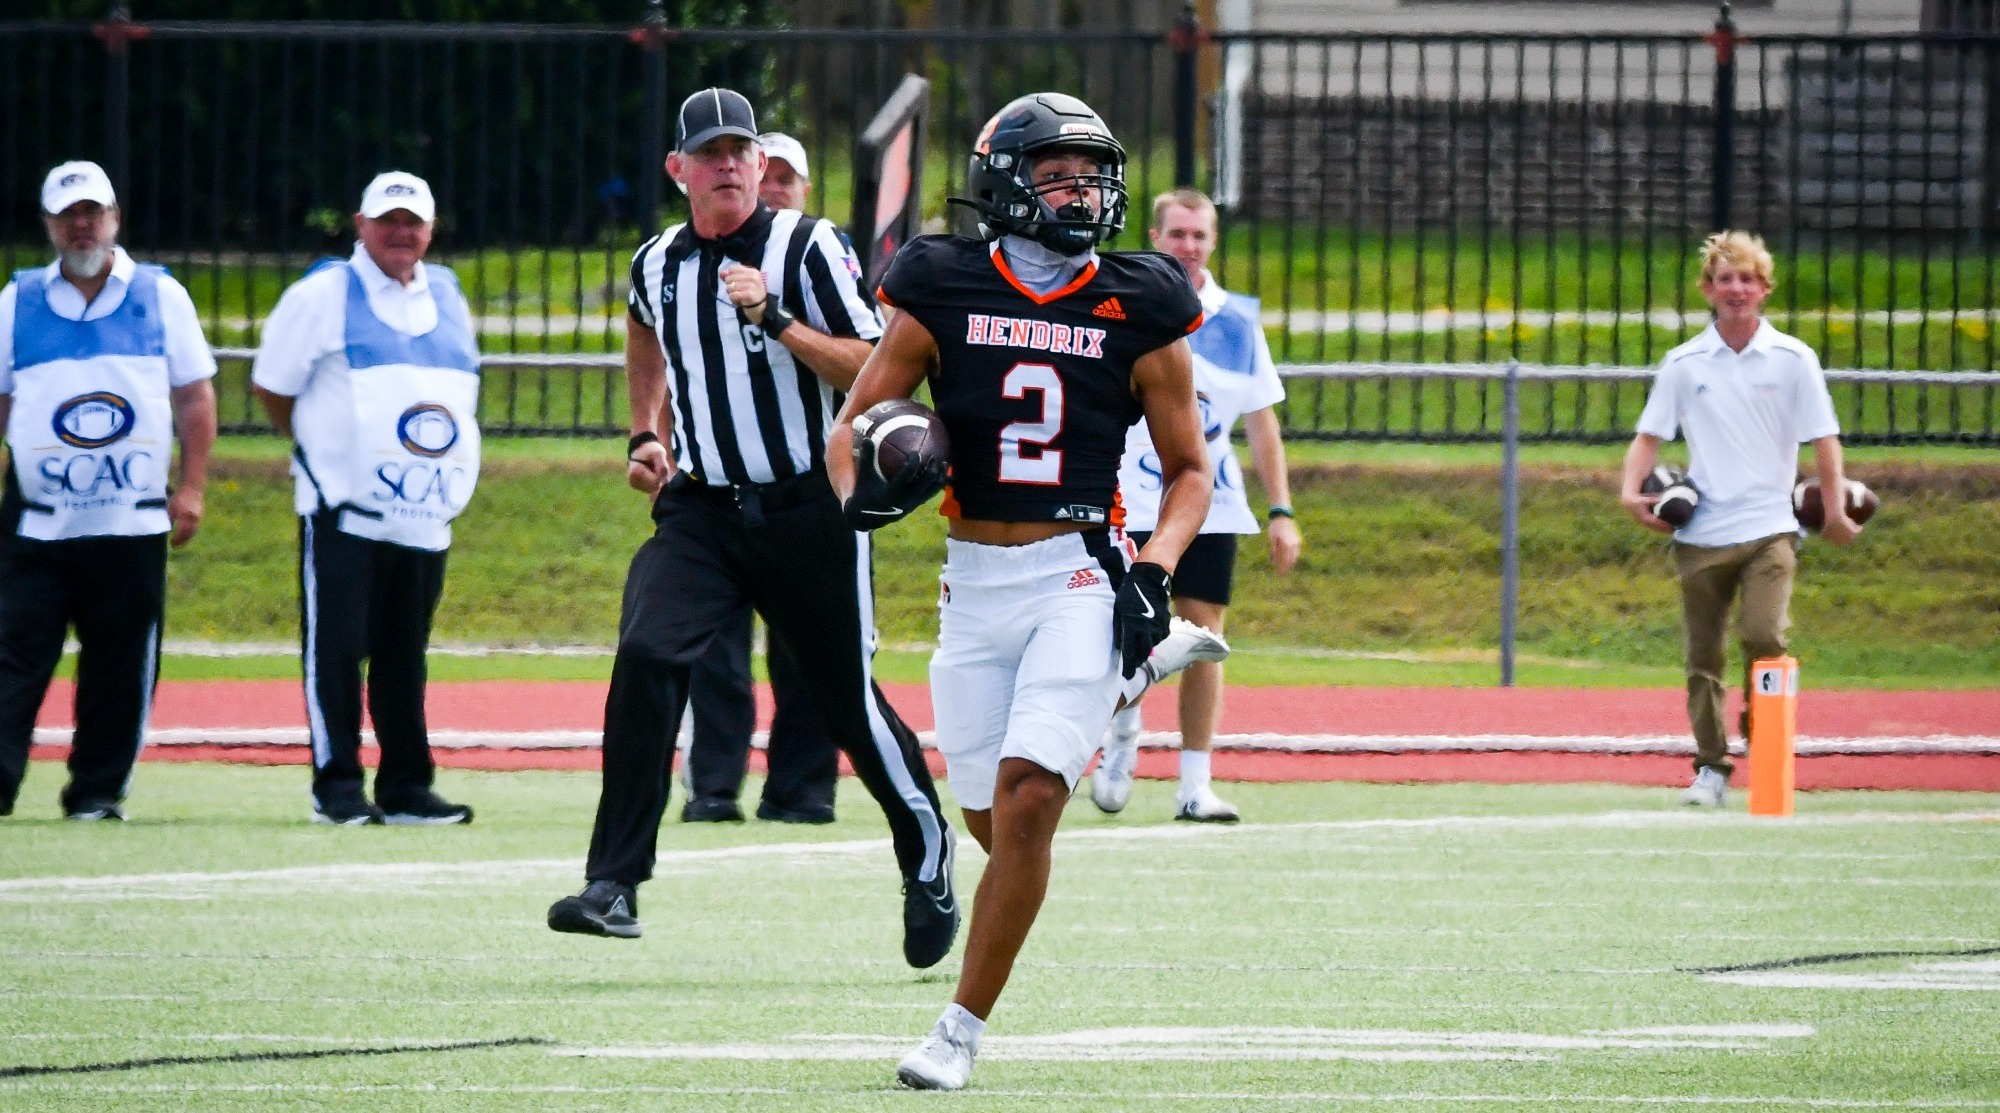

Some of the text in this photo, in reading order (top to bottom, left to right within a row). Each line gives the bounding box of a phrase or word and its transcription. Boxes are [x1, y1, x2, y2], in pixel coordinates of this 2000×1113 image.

[966, 314, 1107, 358] HENDRIX
[1092, 307, 1126, 321] adidas
[998, 361, 1065, 486] 2
[37, 451, 152, 497] SCAC
[372, 461, 465, 511] SCAC
[1067, 577, 1100, 589] adidas
